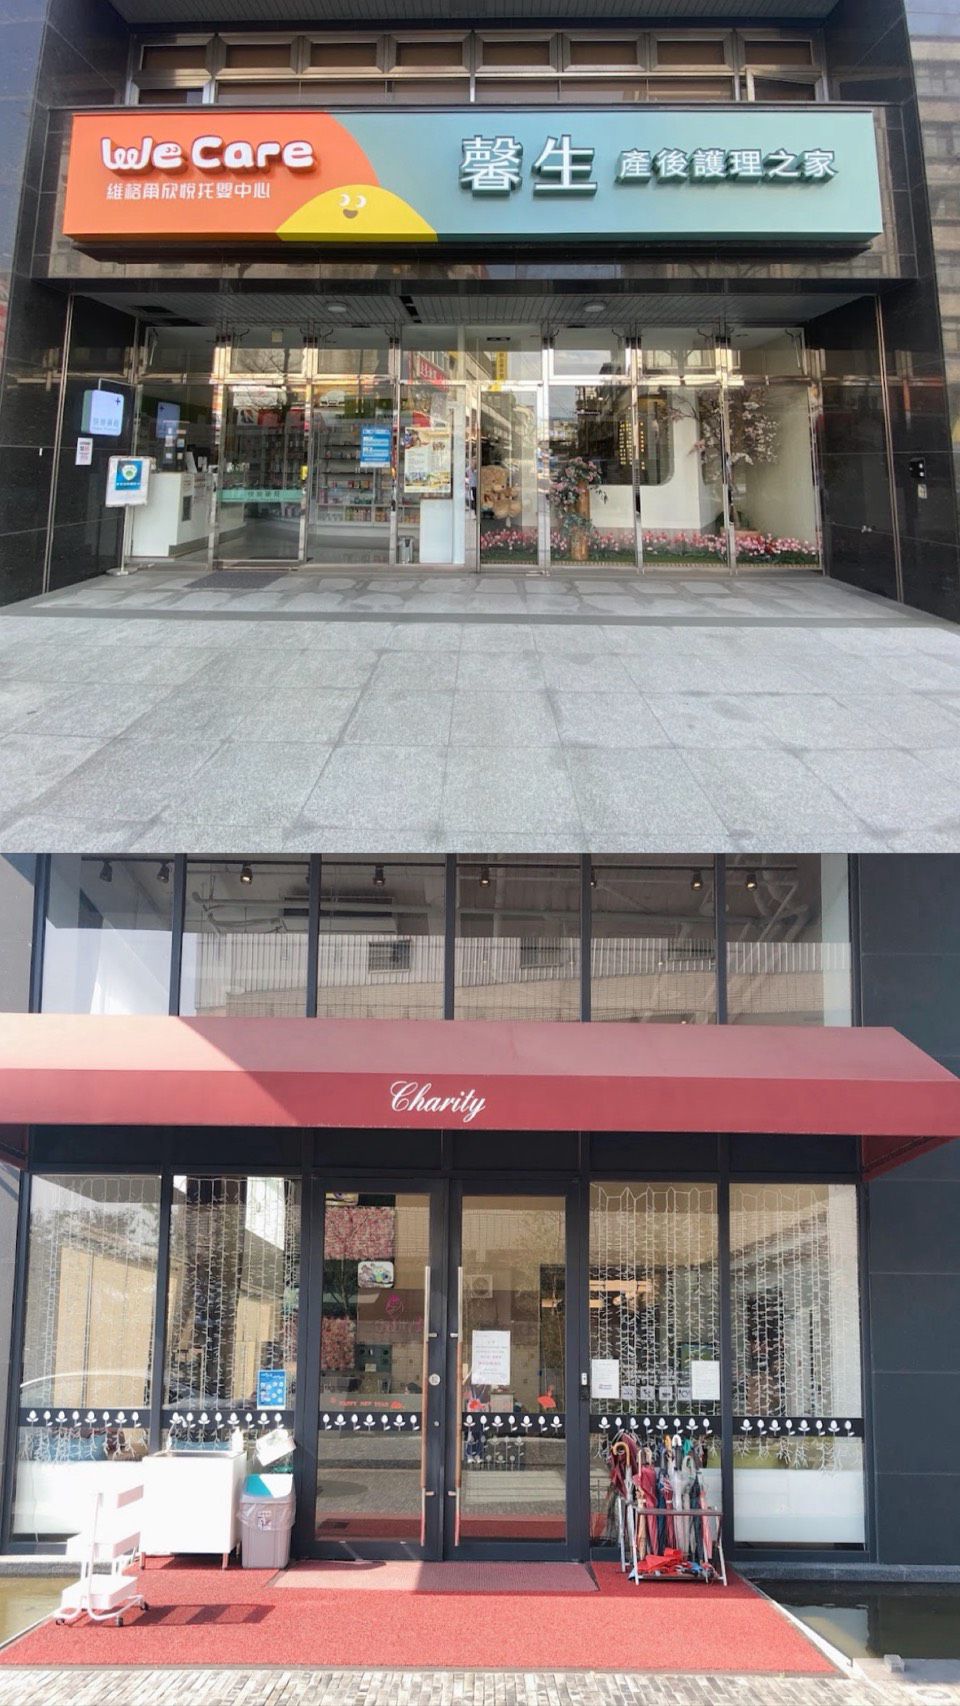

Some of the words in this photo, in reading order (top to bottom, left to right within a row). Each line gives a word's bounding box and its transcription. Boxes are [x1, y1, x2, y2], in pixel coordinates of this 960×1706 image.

[101, 136, 183, 170] We
[191, 135, 314, 171] Care
[459, 134, 598, 195] 馨生
[617, 149, 838, 182] 產後護理之家
[390, 1080, 486, 1123] Charity
